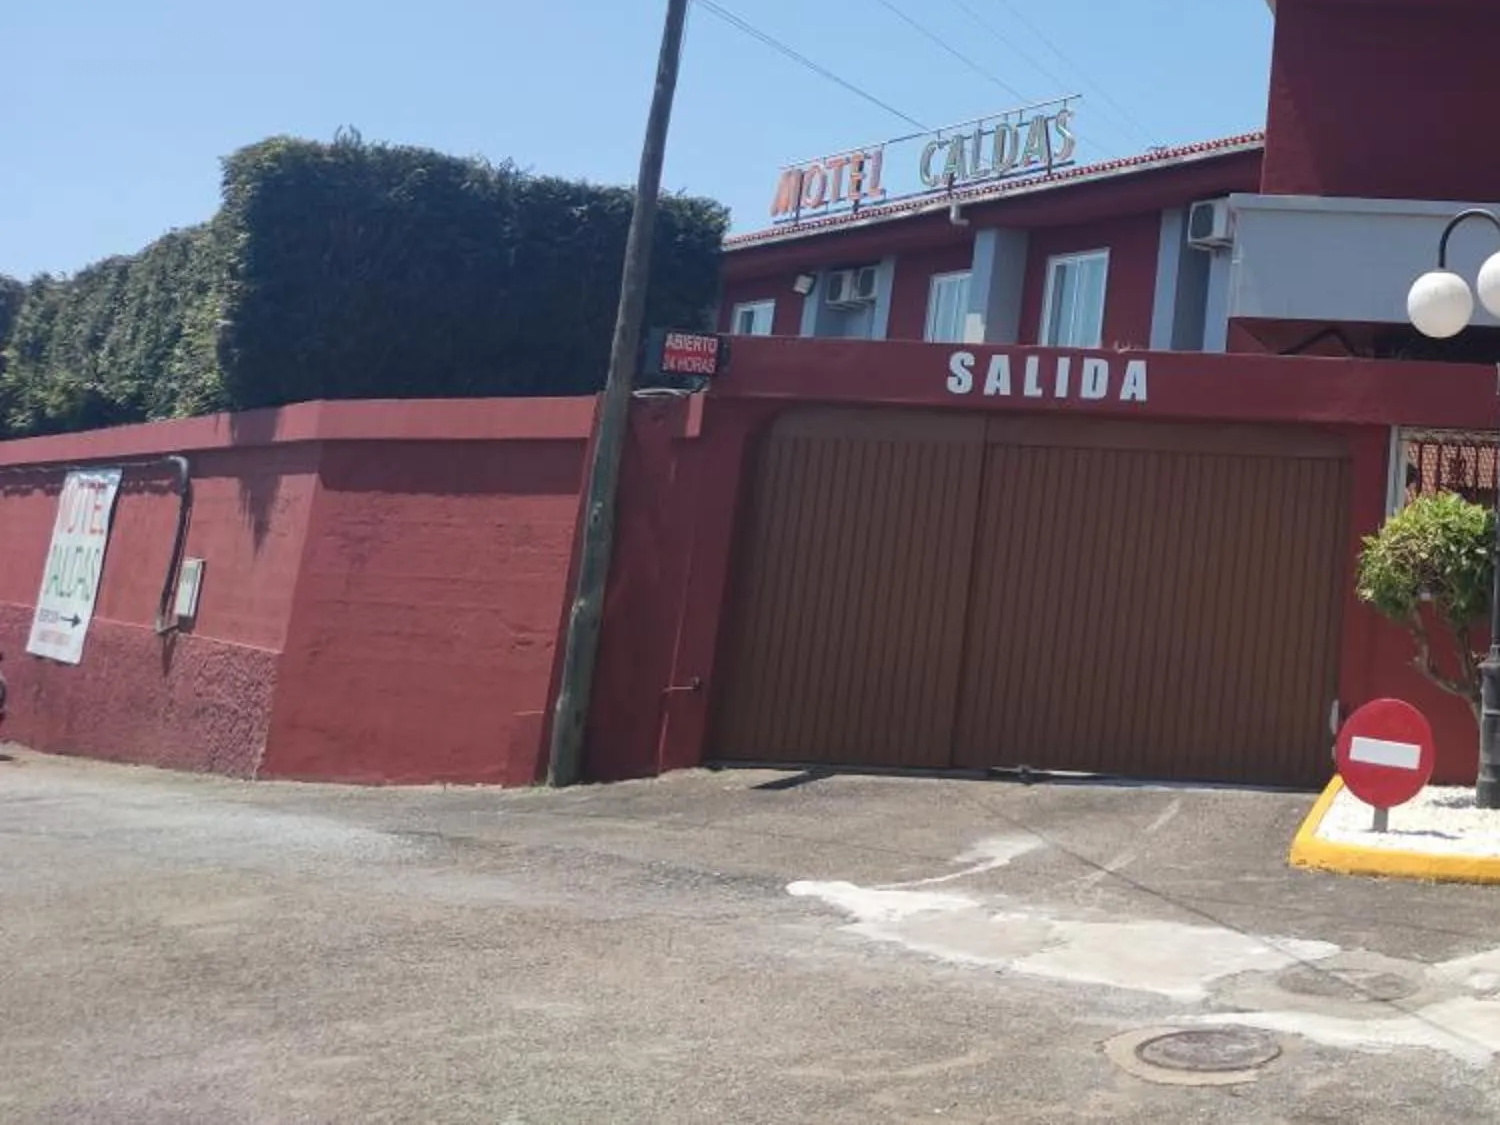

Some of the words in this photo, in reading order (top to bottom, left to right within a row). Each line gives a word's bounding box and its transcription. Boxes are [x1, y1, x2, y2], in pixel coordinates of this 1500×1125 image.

[771, 149, 884, 216] MOTEL
[919, 108, 1076, 187] CALDAS
[665, 333, 718, 352] ABIERTO
[677, 356, 716, 374] HORAS
[946, 351, 1147, 402] SALIDA
